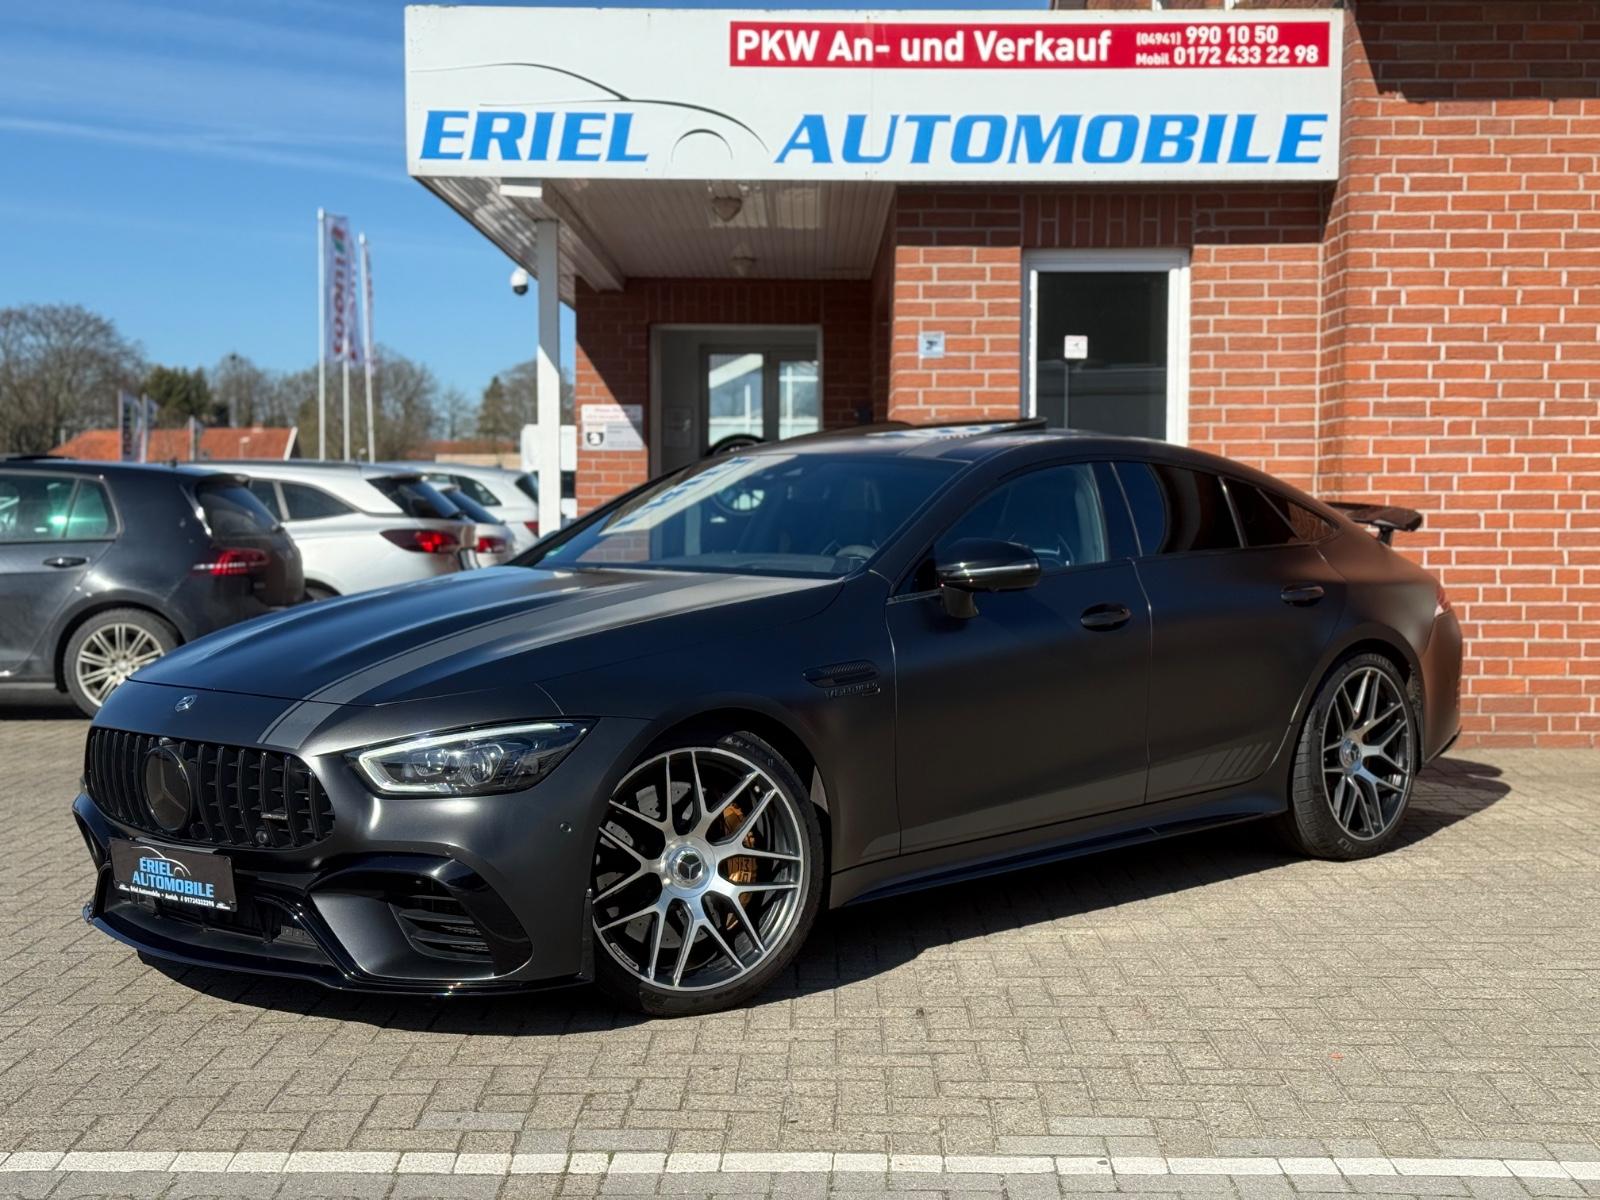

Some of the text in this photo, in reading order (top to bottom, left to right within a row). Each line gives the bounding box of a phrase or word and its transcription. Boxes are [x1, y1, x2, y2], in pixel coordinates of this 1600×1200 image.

[737, 29, 1112, 62] PKW An- und Verkauf
[1135, 25, 1279, 46] (04941) 990 10 50
[1135, 44, 1319, 66] Mobil 0172 433 22 98
[420, 110, 1329, 165] ERIEL AUTOMOBILE
[139, 858, 174, 877] ERIEL
[132, 871, 215, 897] AUTOMOBILE
